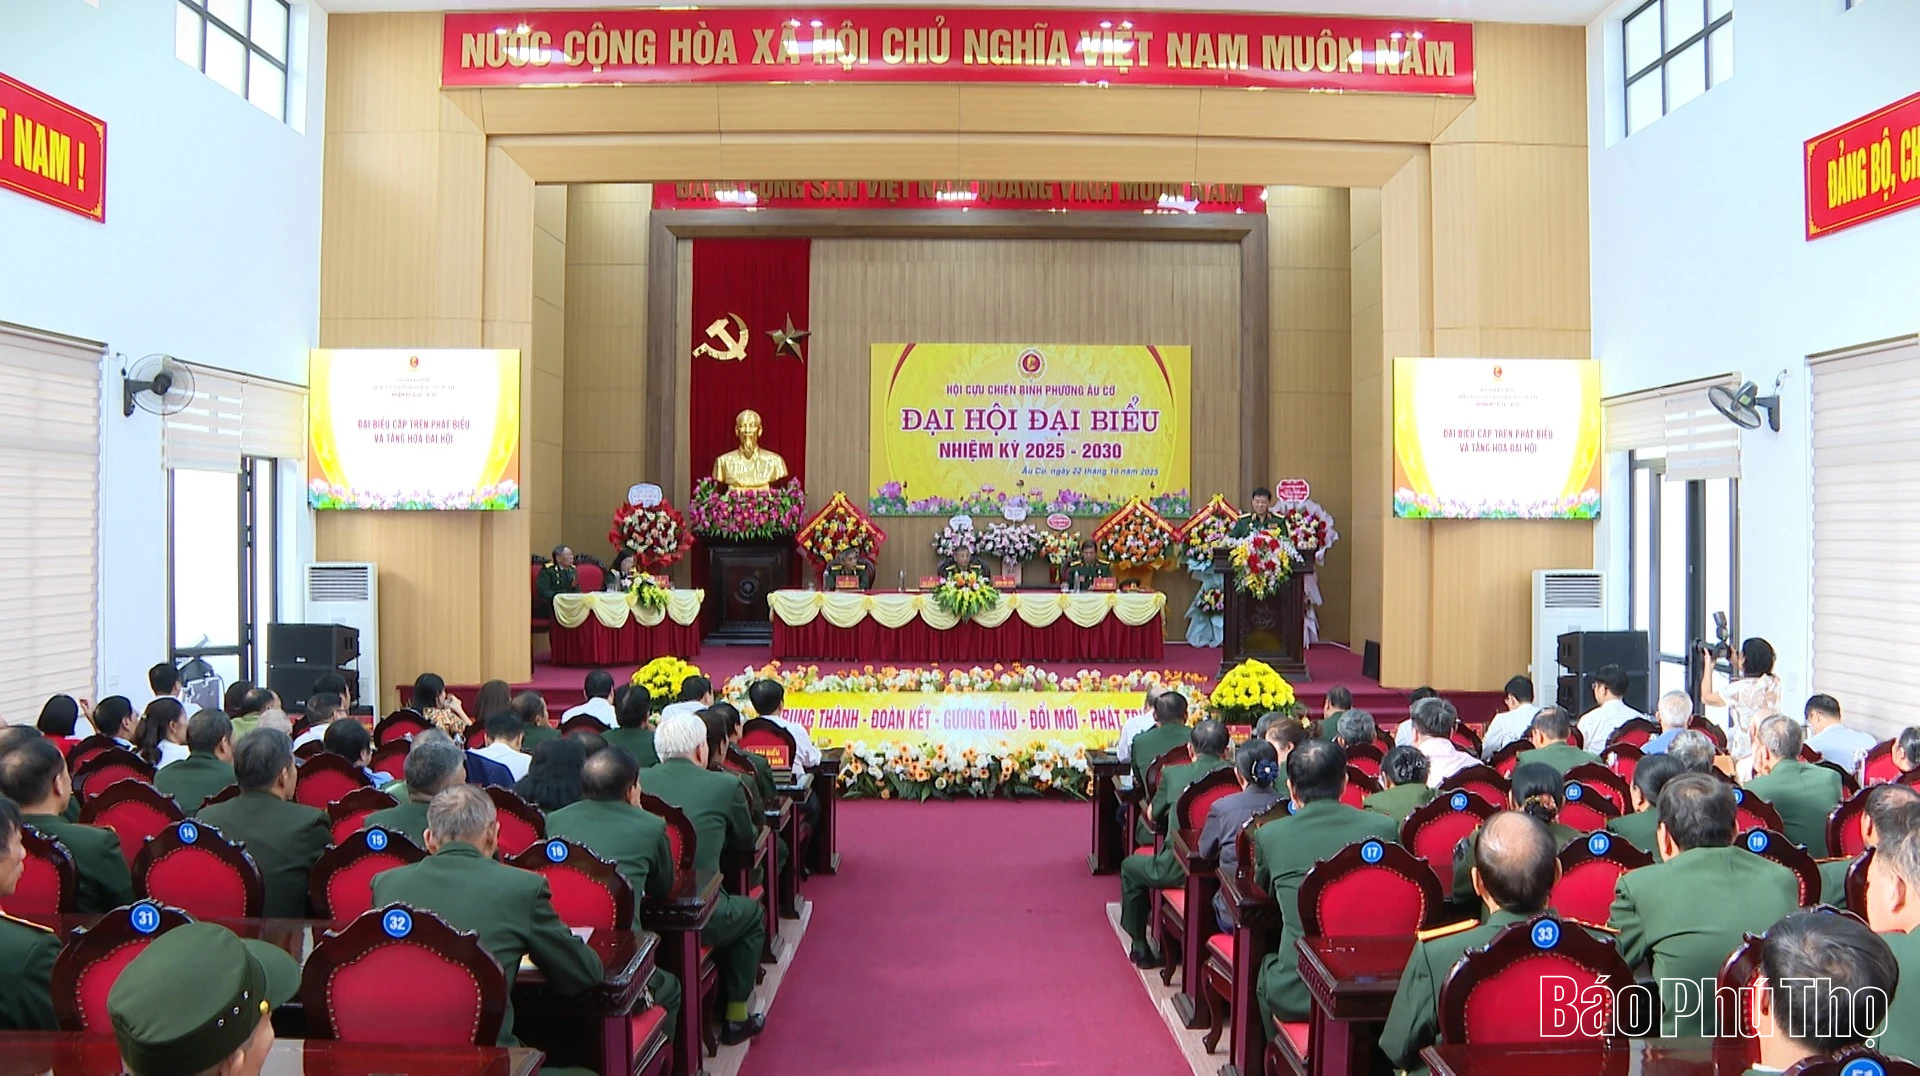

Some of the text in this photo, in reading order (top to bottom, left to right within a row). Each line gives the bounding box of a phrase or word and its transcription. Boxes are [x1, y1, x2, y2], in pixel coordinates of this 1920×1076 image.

[461, 16, 1455, 77] NƯỚC CỘNG HÒA XÃ HỘI CHỦ NGHĨA VIỆT NAM MUÔN NĂM
[14, 112, 70, 186] NAM
[1827, 139, 1867, 210] ĐẢNG
[1870, 126, 1896, 202] BỘ,
[946, 384, 962, 397] HỘI
[1020, 385, 1042, 396] BINH
[901, 396, 1160, 436] ĐẠI HỘI ĐẠI BIỂU
[939, 439, 994, 462] NHIỆM
[999, 439, 1021, 459] KỲ
[1025, 443, 1065, 459] 2025
[1082, 443, 1122, 459] 2030
[1140, 468, 1159, 476] 2025
[782, 708, 815, 729] RUNG
[819, 705, 859, 729] THÀNH
[871, 705, 905, 730] ĐOÀN
[909, 703, 932, 730] KẾT
[943, 707, 986, 730] GƯƠNG
[989, 702, 1017, 730] MẪU
[1030, 701, 1050, 730] ĐỔI
[1054, 703, 1079, 730] MỚI
[1090, 704, 1121, 730] PHÁT
[183, 826, 194, 839] 14
[372, 834, 383, 846] 15
[1367, 846, 1378, 859] 17
[138, 911, 153, 926] 31
[390, 915, 406, 930] 32
[1537, 927, 1553, 942] 33
